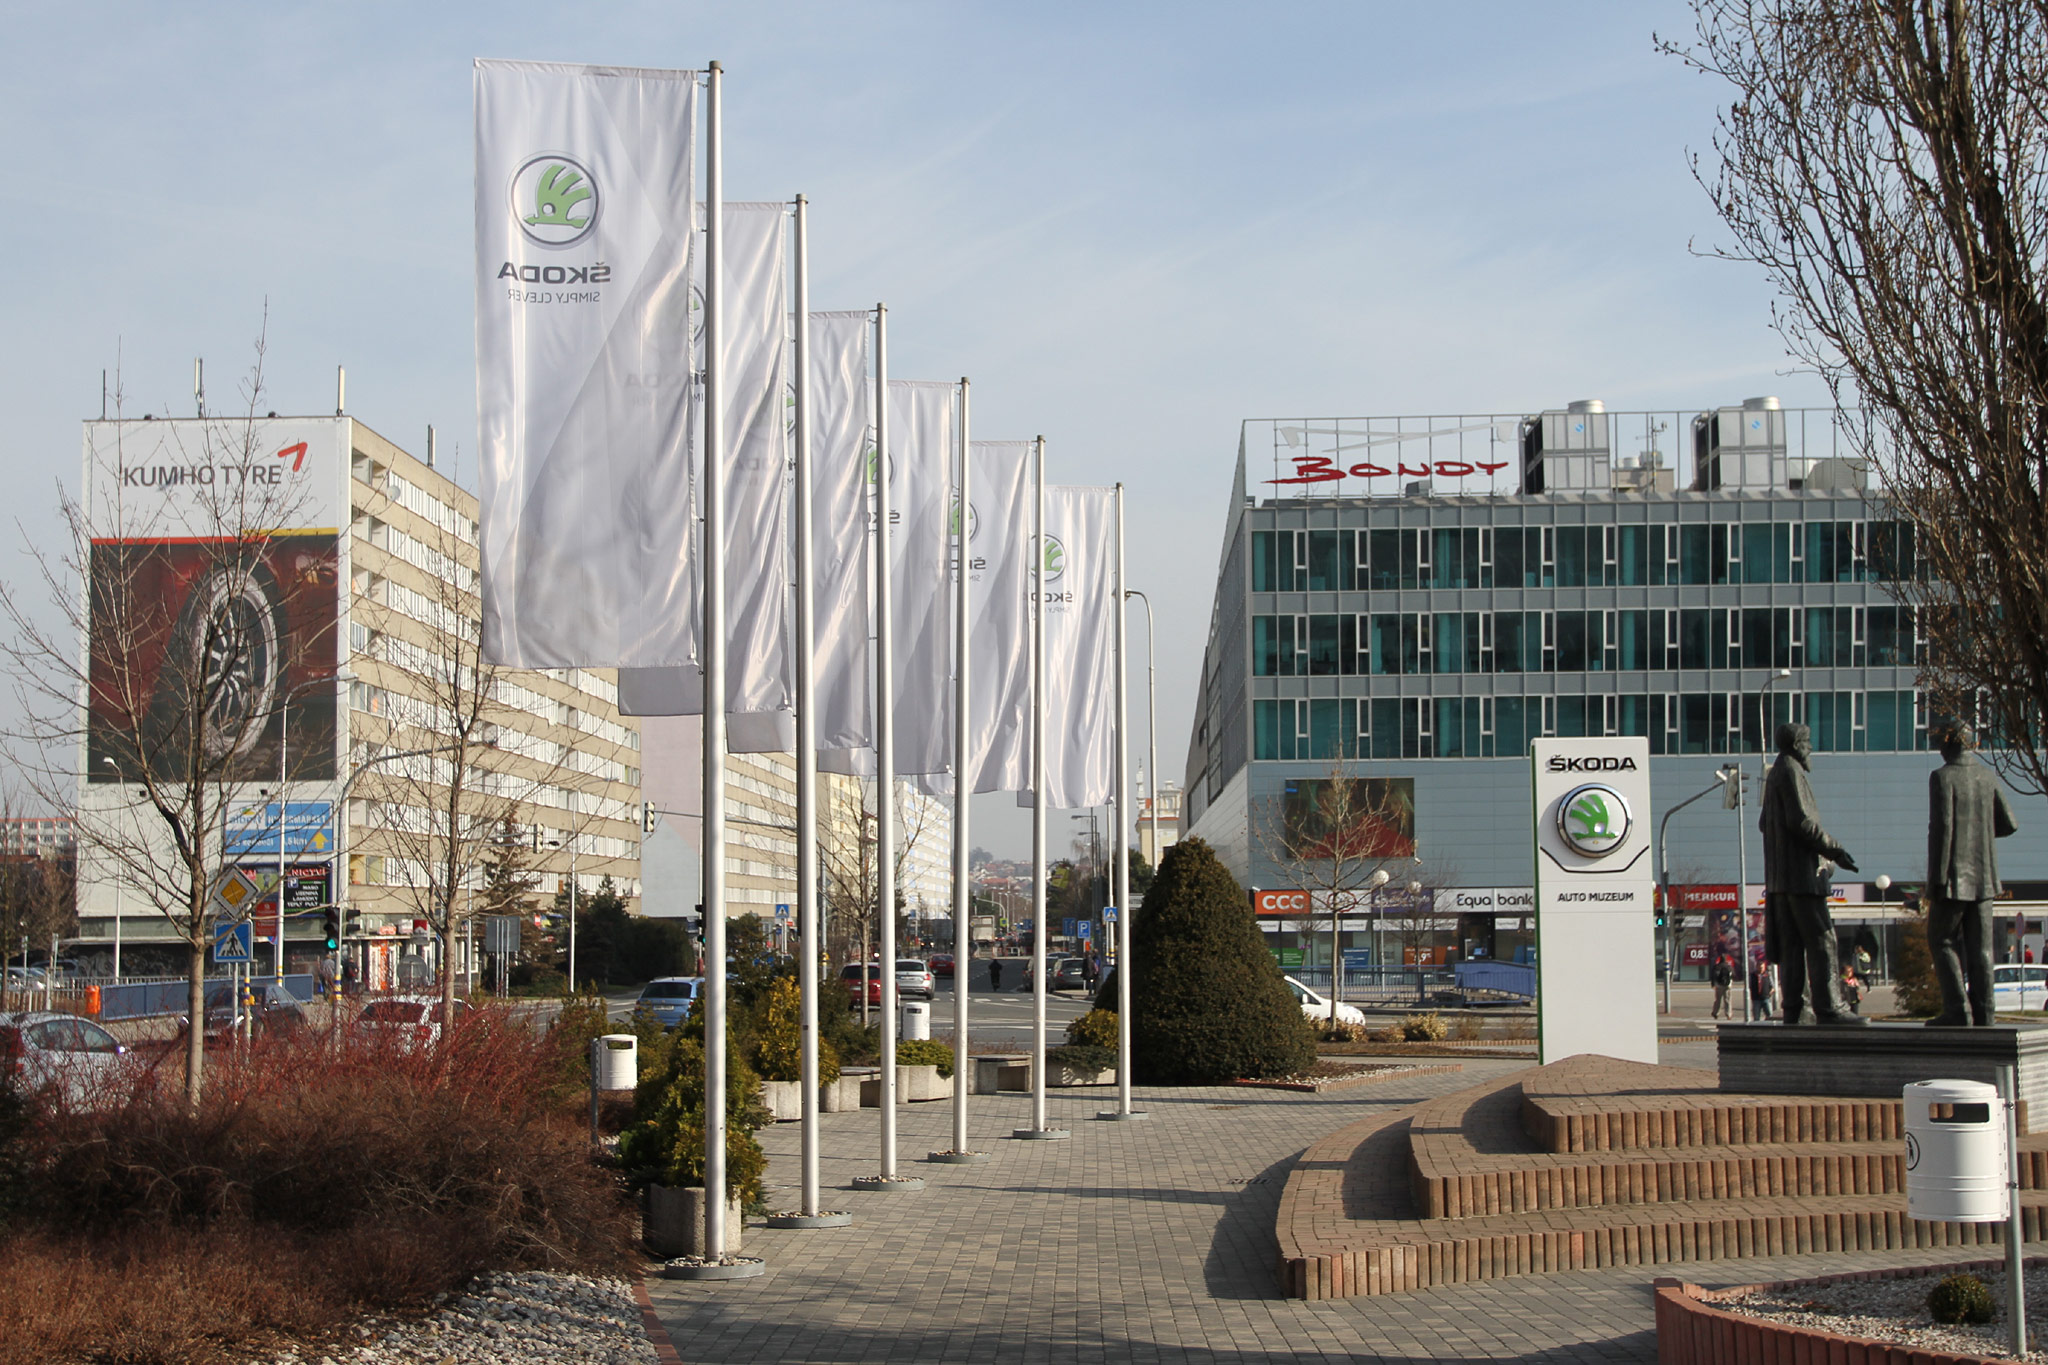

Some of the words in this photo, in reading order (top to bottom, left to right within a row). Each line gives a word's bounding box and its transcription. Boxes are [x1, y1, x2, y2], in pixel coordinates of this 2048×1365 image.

[124, 465, 215, 487] KUMHO
[220, 464, 282, 485] TYRE
[1261, 456, 1509, 484] BONDY
[1549, 754, 1637, 772] ŠKODA
[267, 814, 326, 825] HYERMARKET
[1262, 895, 1304, 910] CCC
[1457, 893, 1491, 908] Equa
[1498, 893, 1533, 906] bank
[1558, 893, 1586, 902] AUTO
[1589, 893, 1634, 902] MUZEUM
[1684, 892, 1736, 902] MERKUR
